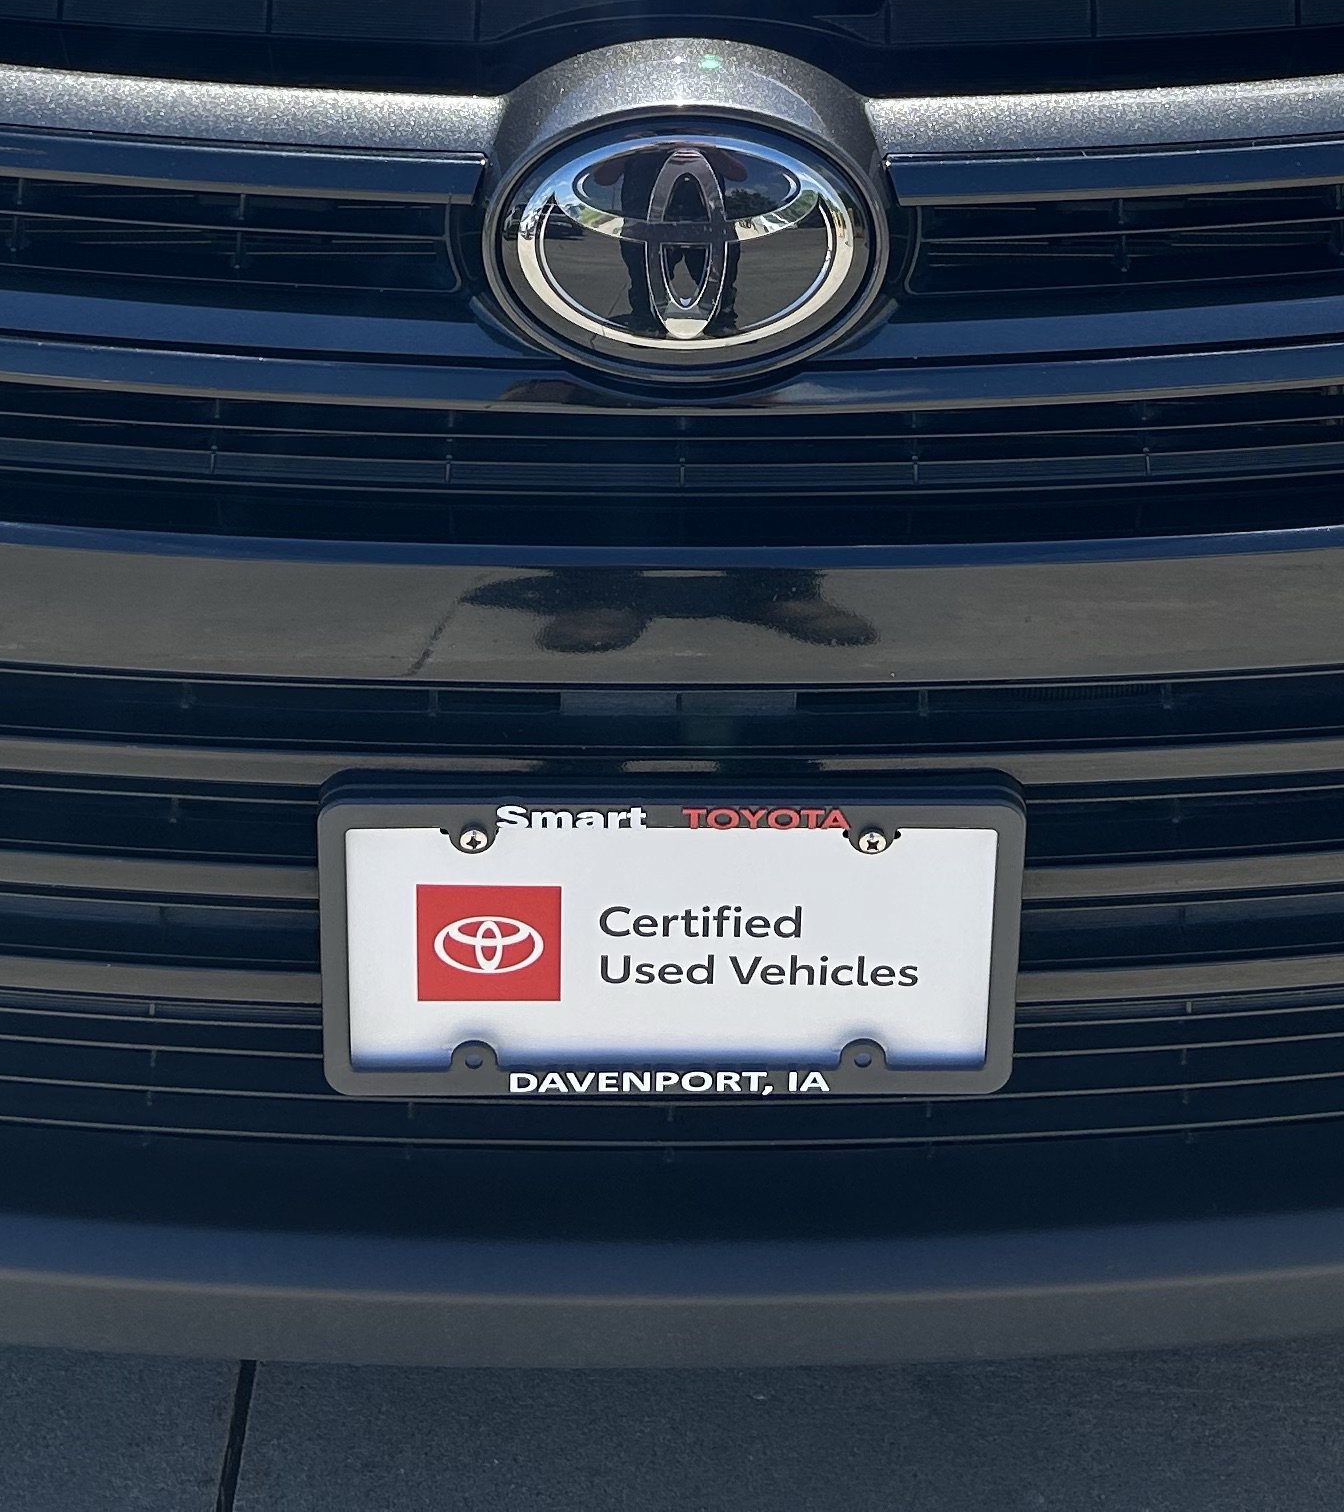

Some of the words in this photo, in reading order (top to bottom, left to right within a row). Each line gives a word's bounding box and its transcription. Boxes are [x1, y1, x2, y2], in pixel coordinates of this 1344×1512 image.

[495, 805, 648, 831] Smart
[682, 806, 851, 831] TOYOTA
[598, 905, 803, 939] Certified
[599, 953, 715, 986] Used
[729, 955, 920, 989] Vehicles
[508, 1071, 774, 1097] DAVENPORT,
[788, 1071, 831, 1093] IA
